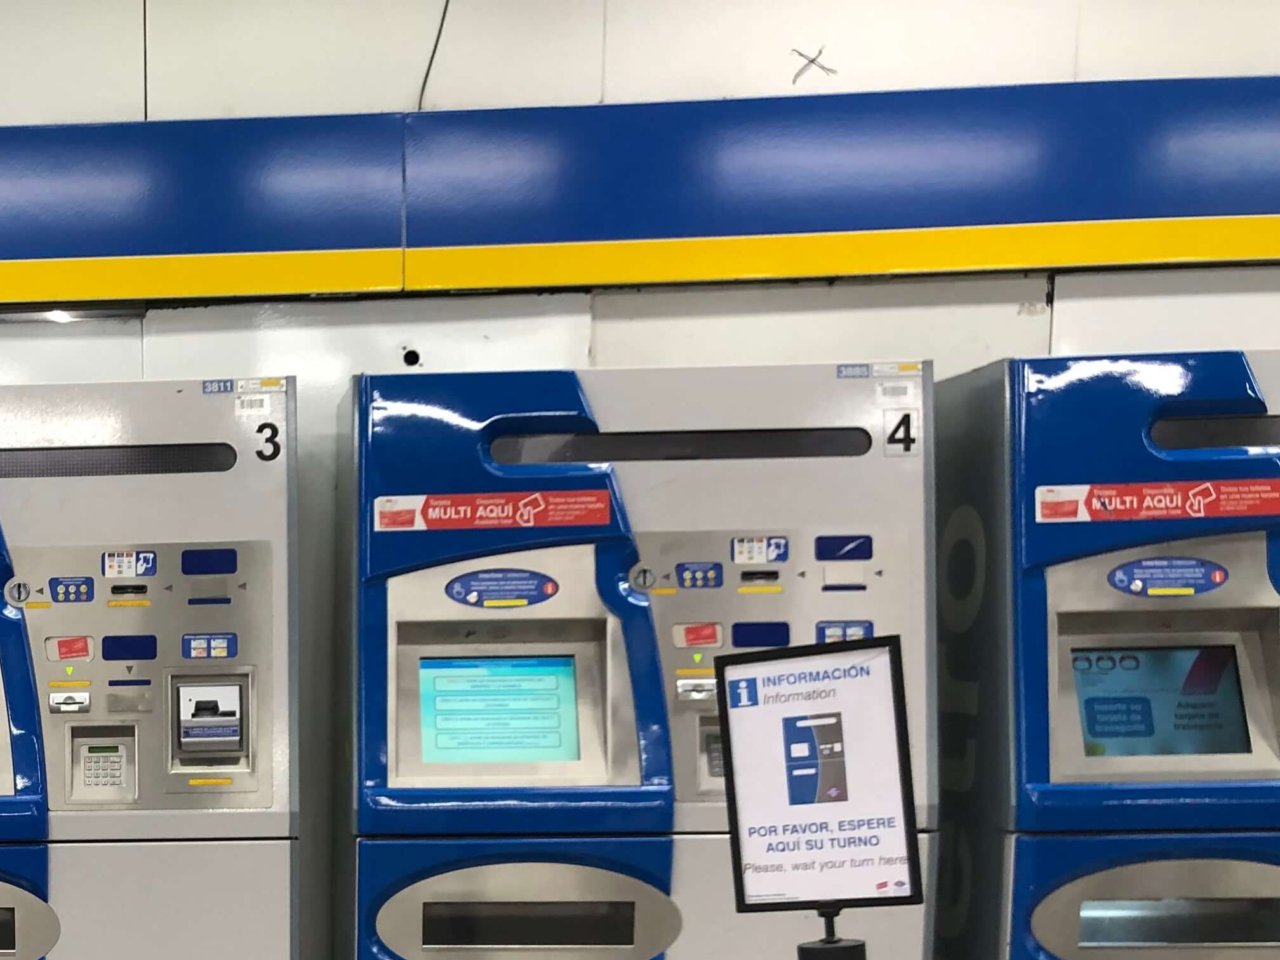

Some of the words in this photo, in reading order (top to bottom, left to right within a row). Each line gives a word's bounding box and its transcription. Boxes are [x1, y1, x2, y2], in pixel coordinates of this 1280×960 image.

[205, 382, 232, 392] 3811
[255, 422, 281, 461] 3
[887, 413, 916, 452] 4
[1092, 496, 1137, 510] MULTI
[1143, 492, 1182, 508] AQUÍ
[428, 506, 472, 519] MULTI
[476, 502, 513, 518] AQUÍ
[762, 665, 871, 688] INFORMACIÓN
[763, 687, 836, 705] Information
[748, 825, 778, 838] POR
[782, 821, 833, 835] FAVOR,
[838, 816, 896, 832] ESPERE
[765, 837, 800, 853] AQUÍ
[805, 839, 824, 850] SU
[829, 834, 880, 849] TURNO
[742, 861, 787, 875] Please,
[791, 860, 816, 871] wait
[819, 859, 846, 873] your
[849, 857, 875, 868] turn
